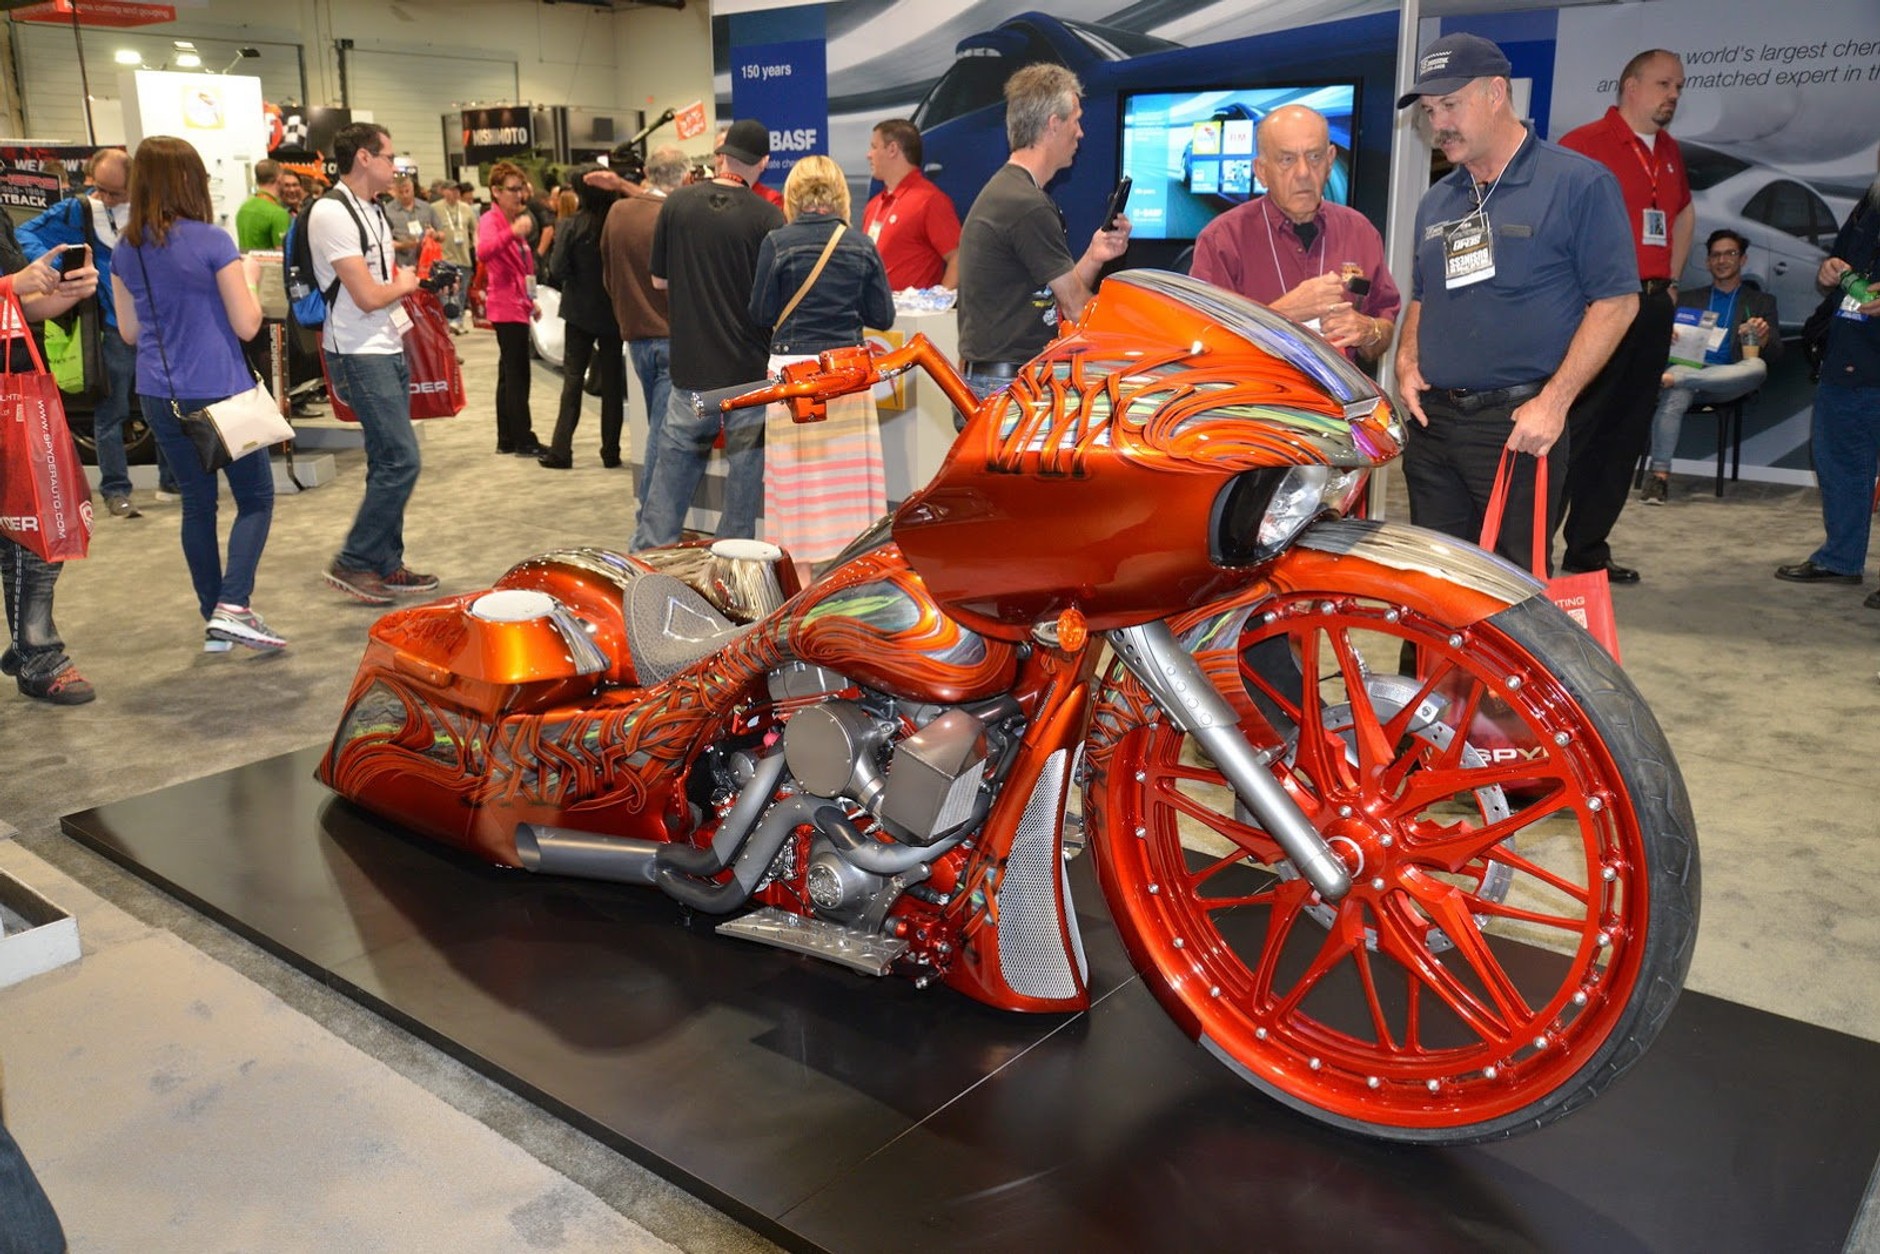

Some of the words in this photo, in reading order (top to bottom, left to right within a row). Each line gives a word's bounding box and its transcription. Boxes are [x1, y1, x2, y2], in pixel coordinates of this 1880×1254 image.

[1686, 46, 1755, 65] world's
[1760, 42, 1828, 64] largest
[741, 64, 760, 79] 150
[761, 64, 792, 81] years
[1775, 66, 1838, 87] expert
[1843, 64, 1861, 82] in
[769, 129, 817, 151] BASF
